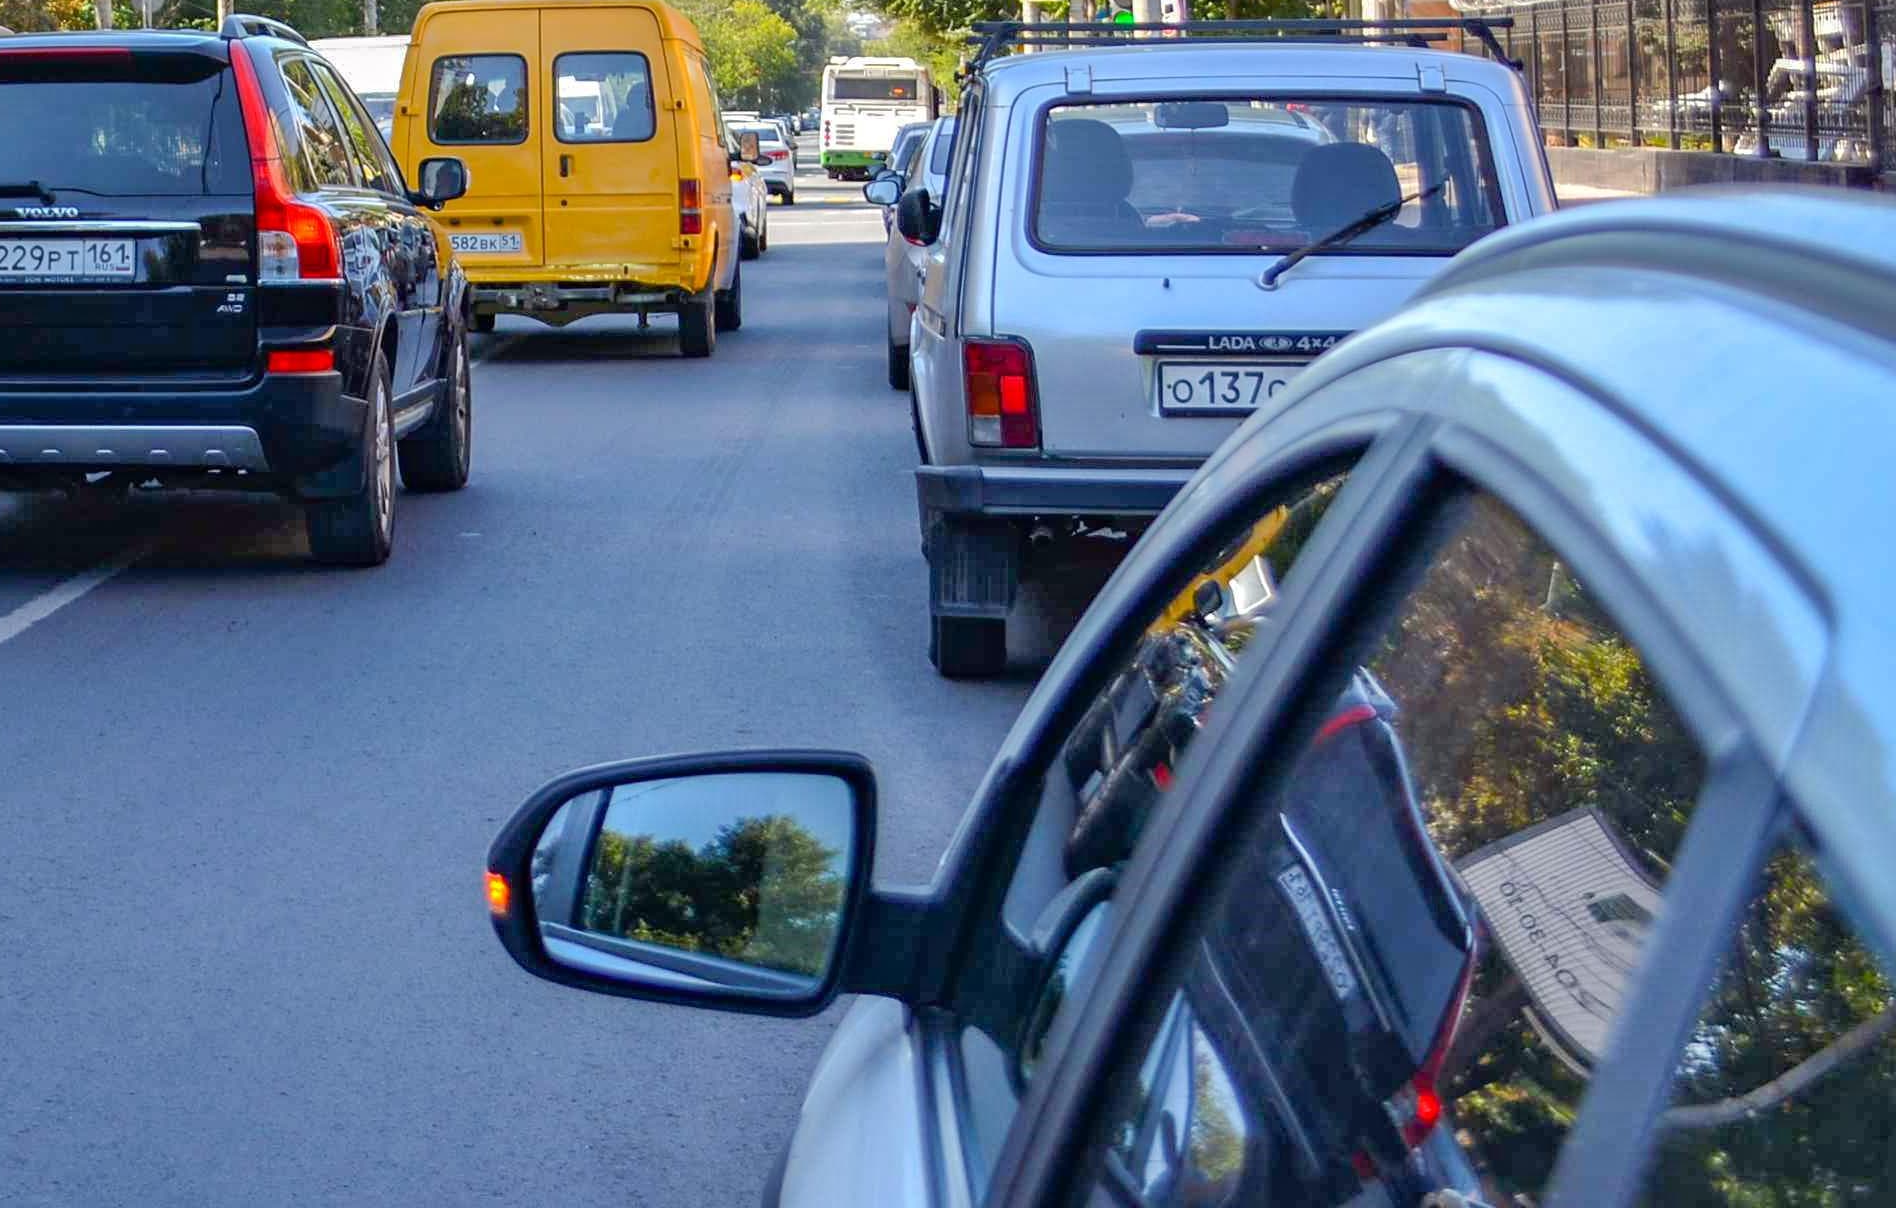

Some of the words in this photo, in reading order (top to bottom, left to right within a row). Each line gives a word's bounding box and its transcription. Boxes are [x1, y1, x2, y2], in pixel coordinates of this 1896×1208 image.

[15, 207, 79, 218] VOLVO
[451, 236, 498, 250] 582ВК
[502, 234, 517, 247] 51
[87, 243, 126, 265] 161
[1209, 336, 1255, 350] LADA
